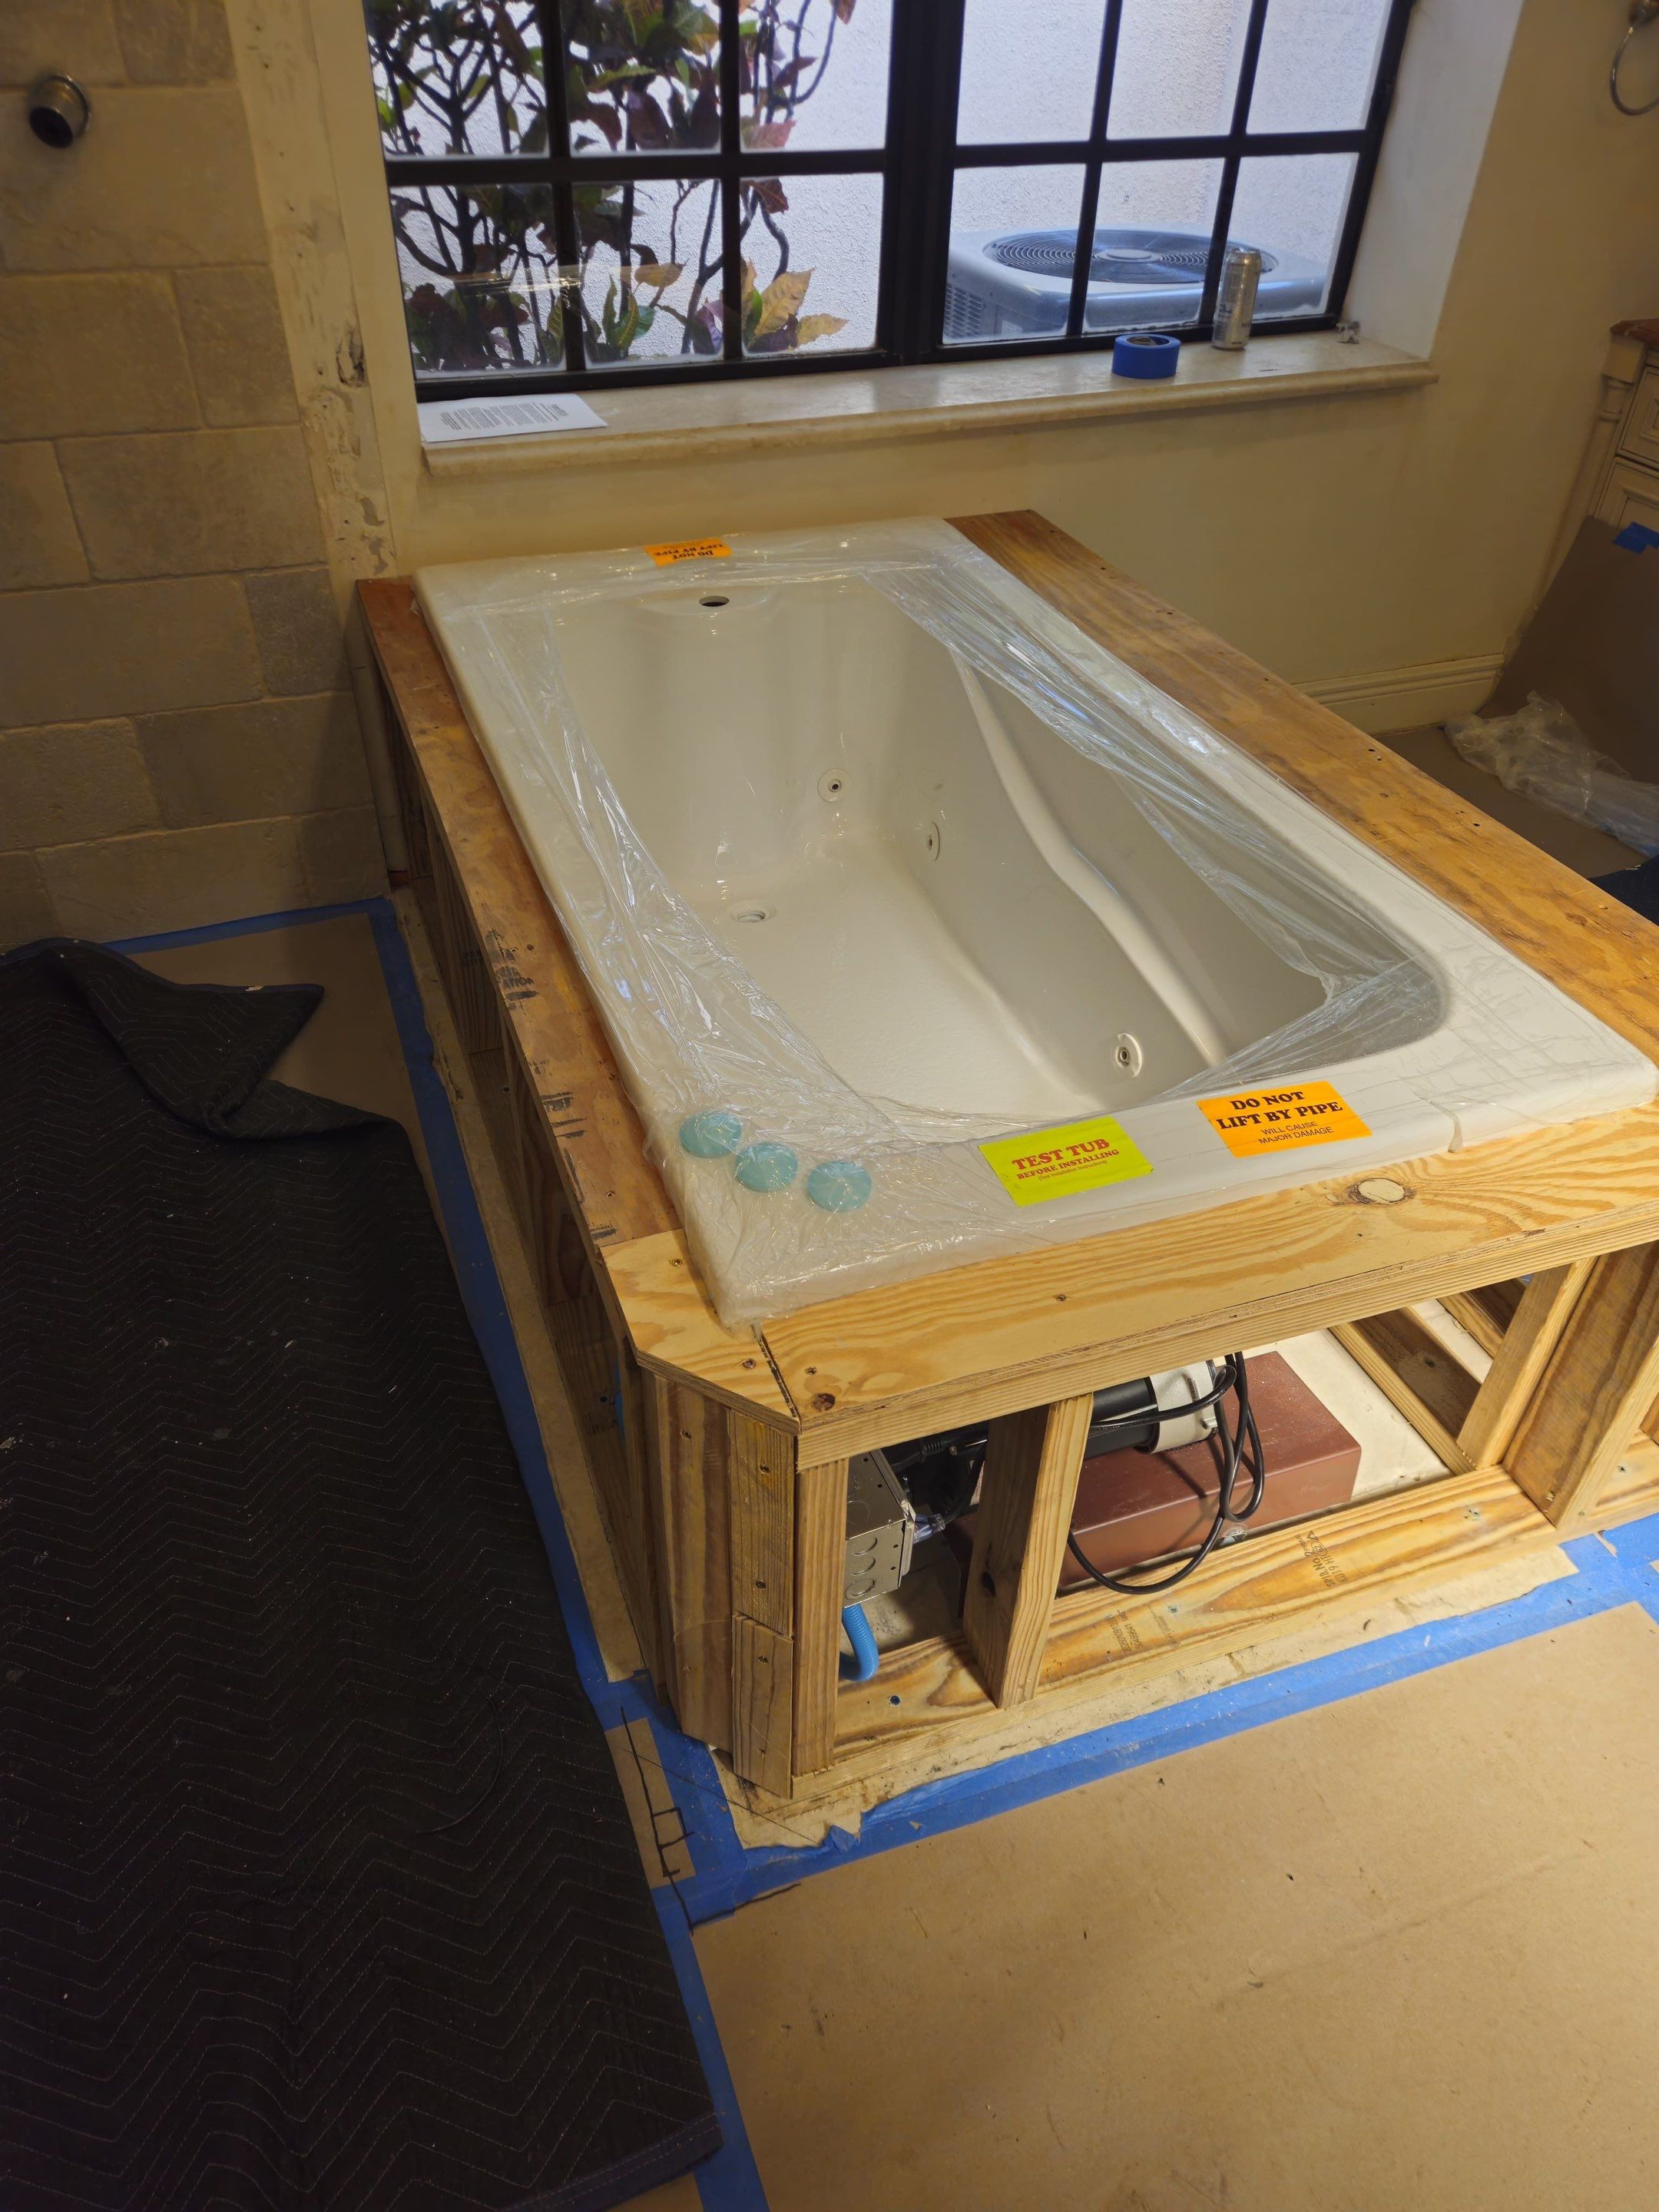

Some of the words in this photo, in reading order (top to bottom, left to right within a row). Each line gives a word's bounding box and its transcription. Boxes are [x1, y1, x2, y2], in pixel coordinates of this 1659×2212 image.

[1230, 1098, 1261, 1111] DO
[1262, 1091, 1306, 1106] NOT
[1216, 1114, 1262, 1130] LIFT
[1263, 1108, 1292, 1122] BY
[1295, 1101, 1343, 1118] PIPE
[1258, 1133, 1293, 1144] MAJOR
[1294, 1126, 1334, 1139] DAMAGE
[1262, 1126, 1286, 1136] WILL
[1286, 1121, 1320, 1132] CAUSE
[1012, 1149, 1064, 1170] TEST
[1065, 1138, 1110, 1156] TUB
[1017, 1164, 1058, 1180] BEFORE
[1058, 1149, 1120, 1169] INSTALLING
